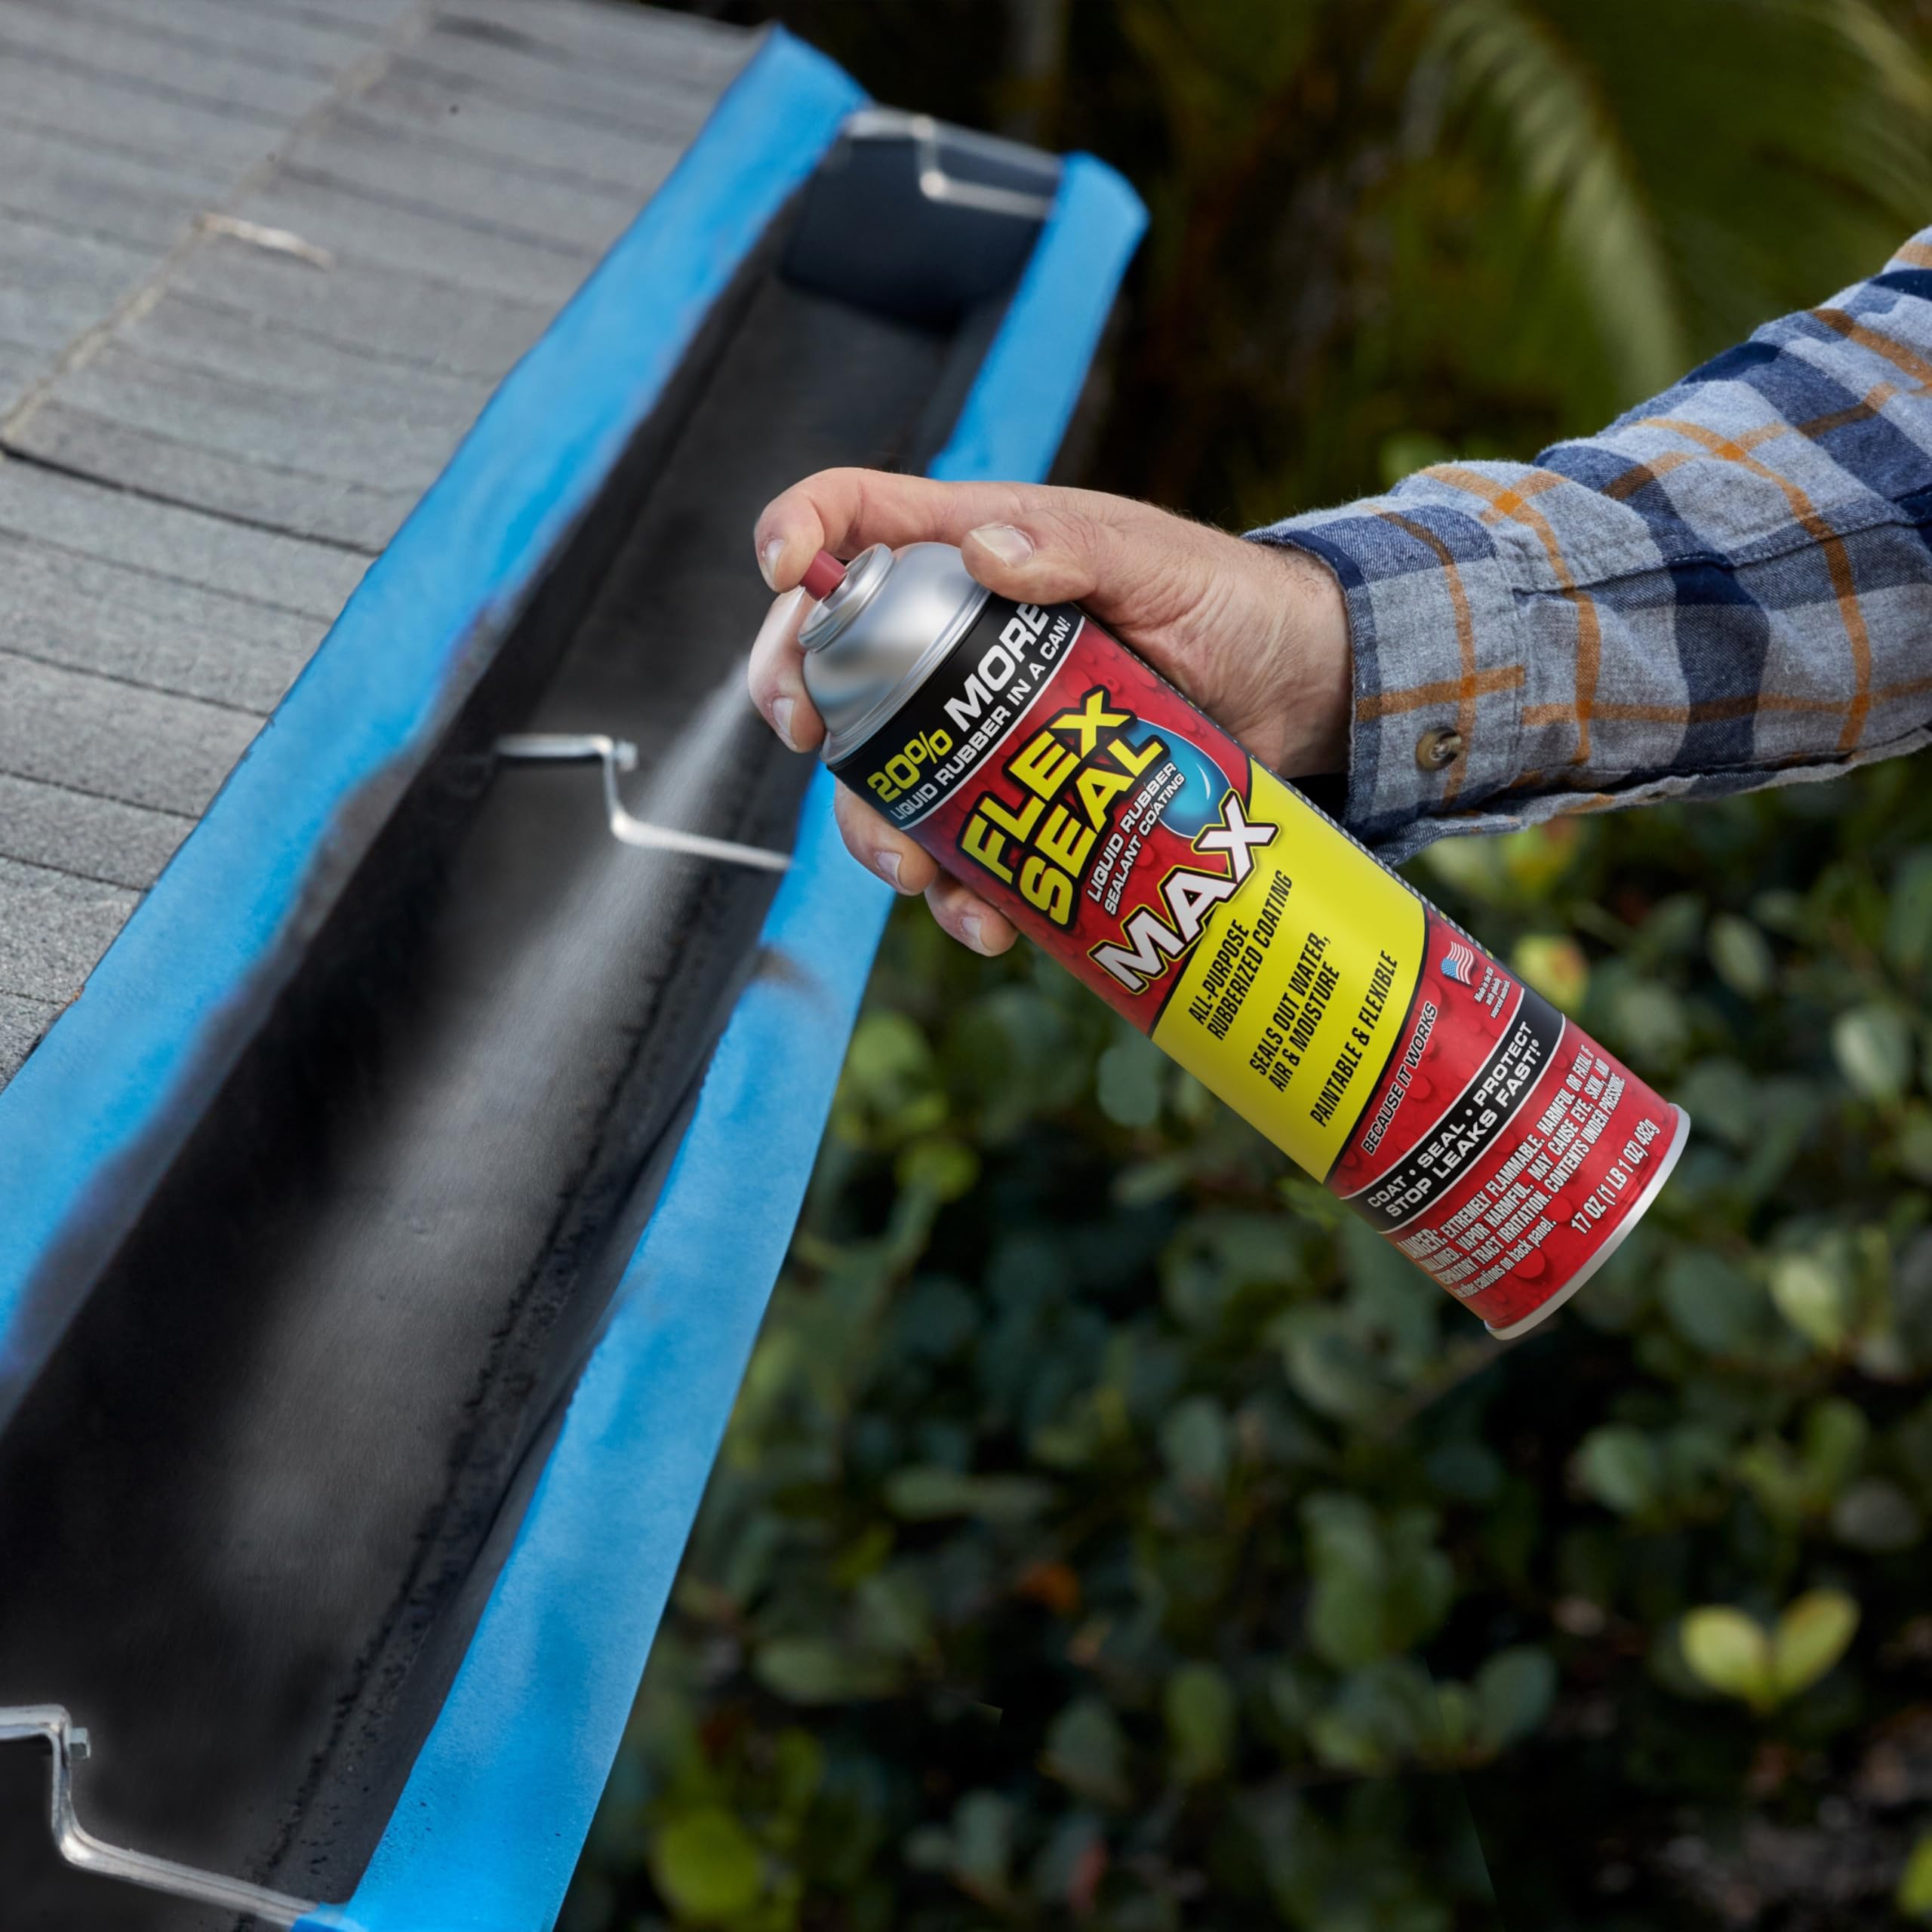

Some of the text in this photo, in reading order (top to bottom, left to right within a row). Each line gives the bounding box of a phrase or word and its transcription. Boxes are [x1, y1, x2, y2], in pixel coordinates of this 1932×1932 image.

[868, 604, 1049, 803] 20% MORE
[891, 616, 1071, 820] LIQUID RUBBER IN A CAN!
[961, 690, 1131, 885] FLEX
[1020, 739, 1164, 926] SEAL
[1088, 761, 1177, 902] LIQUID RUBBER
[1094, 794, 1275, 991] MAX
[1104, 772, 1185, 915] SEALANT COATING
[1188, 918, 1250, 1026] ALL-PURPOSE
[1207, 869, 1293, 1041] RUBBERIZED COATING
[1249, 931, 1331, 1076] SEALS OUT WATER,
[1268, 961, 1340, 1093] AIR & MOISTURE
[1309, 949, 1398, 1128] PAINTABLE & FLEXIBLE
[1361, 1001, 1438, 1155] BECAUSE IT WORKS
[1572, 1052, 1593, 1079] FATAL
[1594, 1057, 1611, 1078] AND
[1367, 1021, 1532, 1208] COAT SEAL PROTECT
[1536, 1088, 1577, 1137] HARMFUL
[1565, 1073, 1583, 1092] OR
[1571, 1098, 1595, 1123] EYE,
[1584, 1075, 1606, 1100] SKIN,
[1386, 1177, 1432, 1217] STOP
[1432, 1109, 1497, 1179] LEAKS
[1472, 1235, 1504, 1265] TRACT
[1496, 1190, 1552, 1244] IRRITATION.
[1544, 1139, 1589, 1193] CONTENTS
[1580, 1109, 1610, 1145] UNDER
[1598, 1072, 1626, 1115] PRESSURE.
[1484, 1134, 1545, 1198] FLAMMABLE.
[1527, 1152, 1553, 1181] MAY
[1547, 1118, 1579, 1156] CAUSE
[1571, 1118, 1660, 1235] 17 OZ (1 LB 1 OZ) 482g
[1439, 1190, 1492, 1239] EXTREMELY
[1456, 1223, 1491, 1251] VAPOR
[1483, 1182, 1534, 1228] HARMFUL.
[1506, 1239, 1534, 1262] back
[1527, 1216, 1557, 1247] panel.
[1473, 1265, 1506, 1290] cautions
[1500, 1257, 1515, 1270] on
